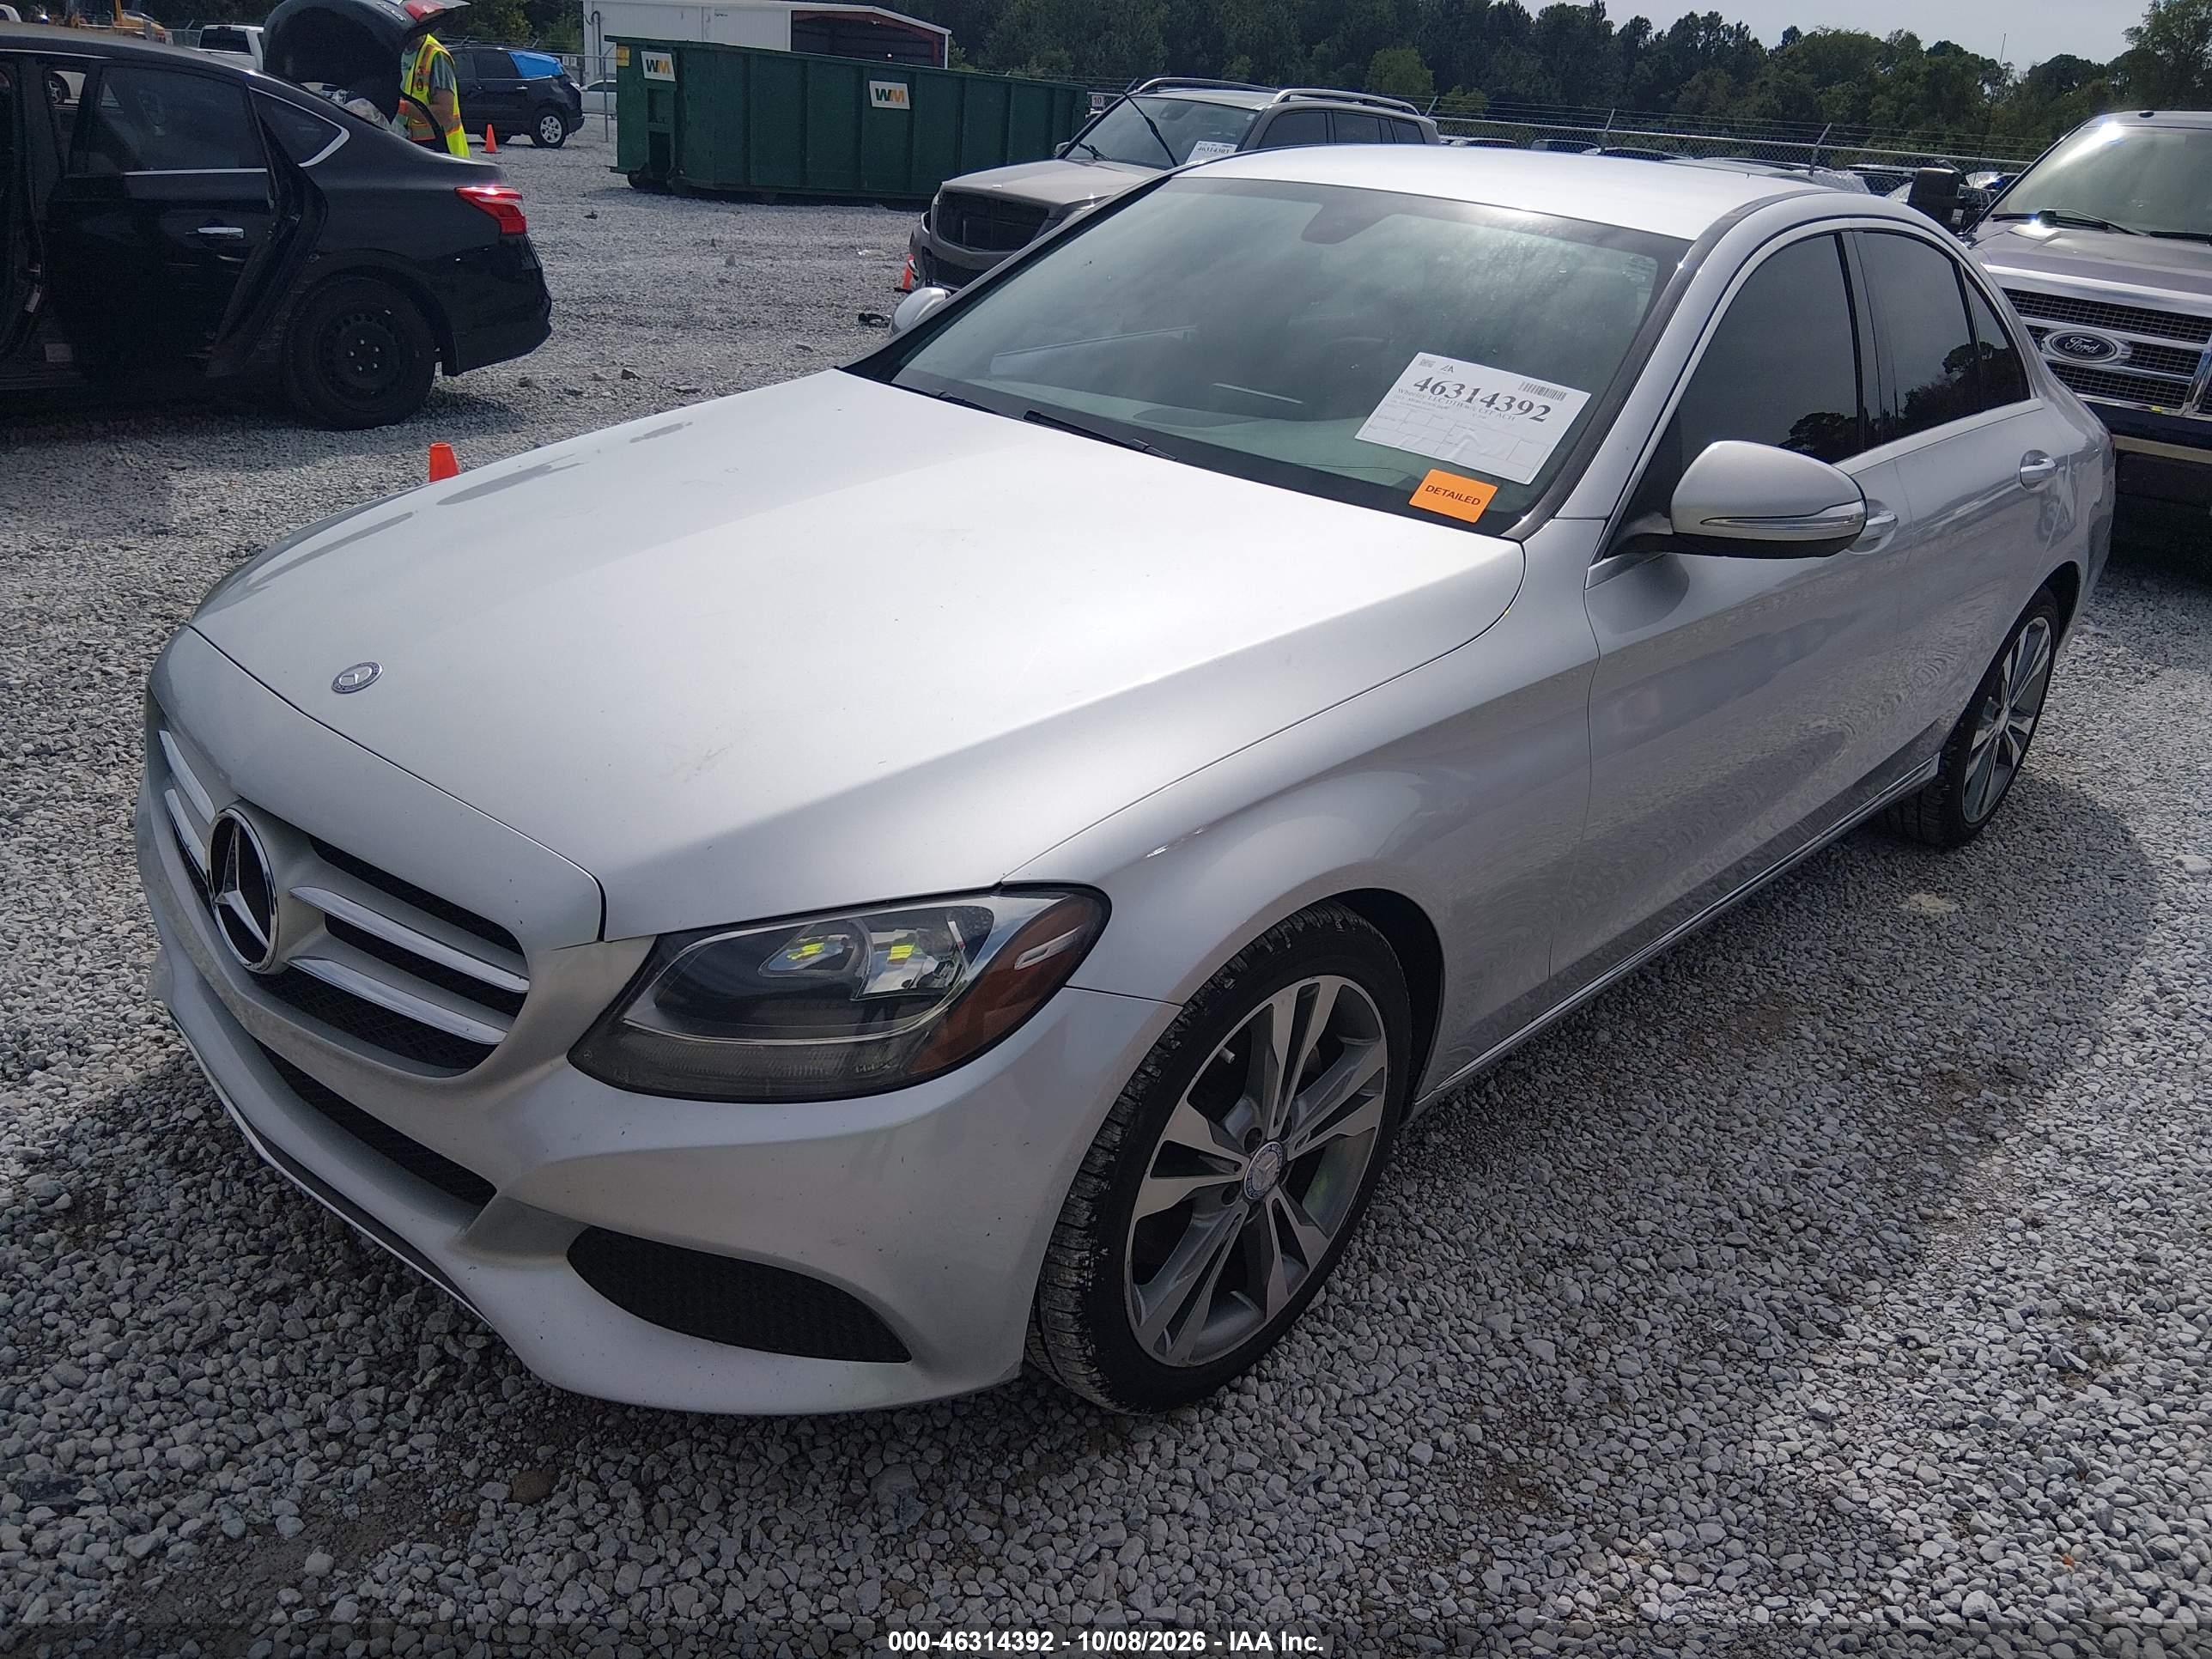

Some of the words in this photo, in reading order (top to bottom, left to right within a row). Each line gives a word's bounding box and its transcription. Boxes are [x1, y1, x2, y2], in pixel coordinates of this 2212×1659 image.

[646, 58, 670, 74] WM
[874, 88, 904, 102] WM
[2064, 337, 2100, 355] Ford
[1413, 376, 1552, 422] 46314392
[1425, 483, 1481, 507] DETAILED
